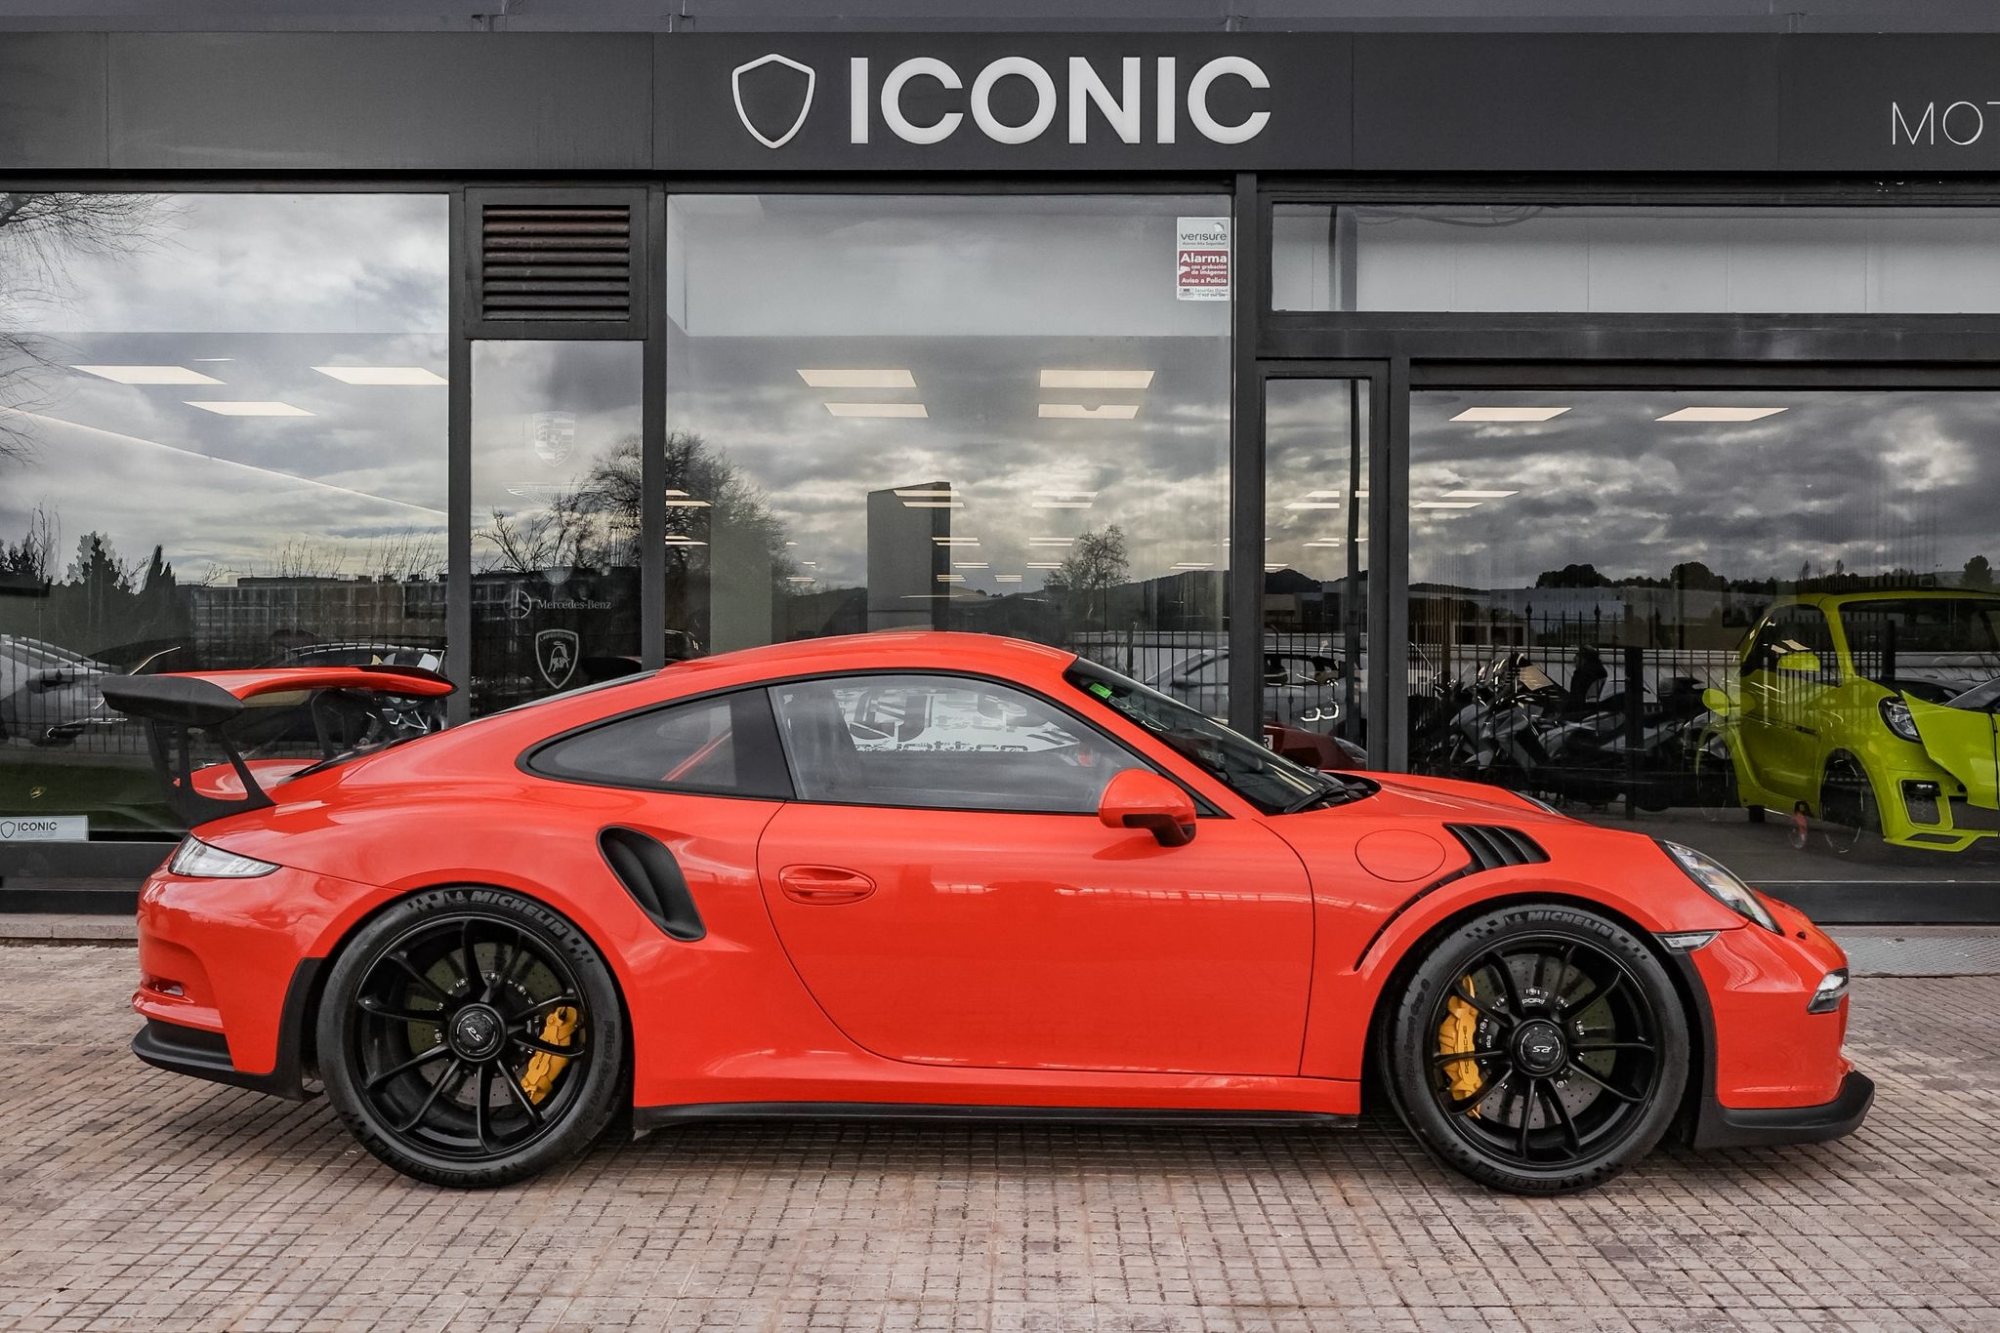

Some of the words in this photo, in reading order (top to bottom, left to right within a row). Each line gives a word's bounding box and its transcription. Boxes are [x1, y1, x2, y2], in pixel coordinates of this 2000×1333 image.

[850, 56, 1272, 145] ICONIC
[1180, 233, 1227, 241] verisure
[1180, 252, 1227, 263] Alarma
[537, 599, 612, 610] Mercedes-Benz
[17, 821, 58, 832] ICONIC
[470, 890, 568, 936] MICHELIN
[1527, 911, 1614, 937] MICHELIN
[465, 1026, 483, 1042] RS
[1462, 1025, 1470, 1075] POSCHE
